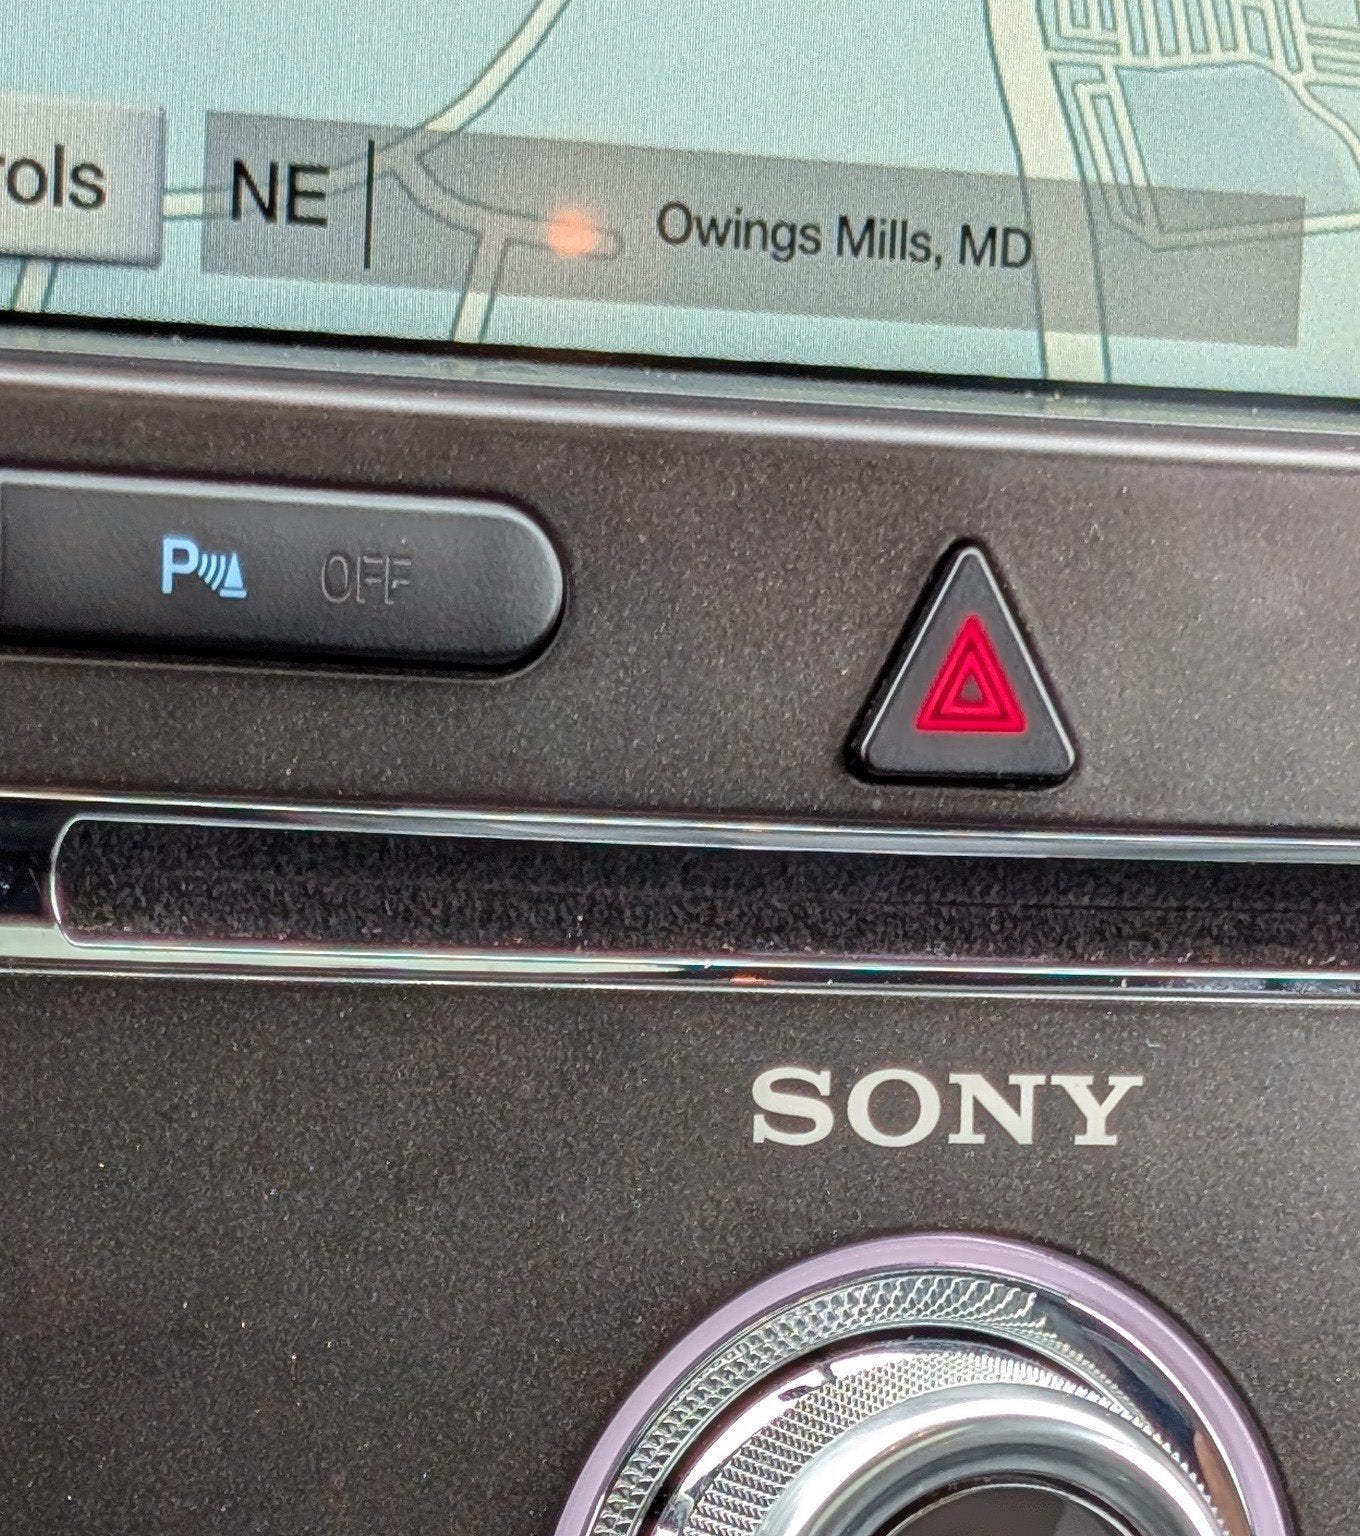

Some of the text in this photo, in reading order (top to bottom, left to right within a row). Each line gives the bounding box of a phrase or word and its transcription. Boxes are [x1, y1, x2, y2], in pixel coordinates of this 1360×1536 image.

[231, 161, 329, 227] NE
[657, 201, 1032, 271] Owings Mills, MD
[161, 536, 411, 604] P OFF
[752, 1067, 1143, 1147] SONY
